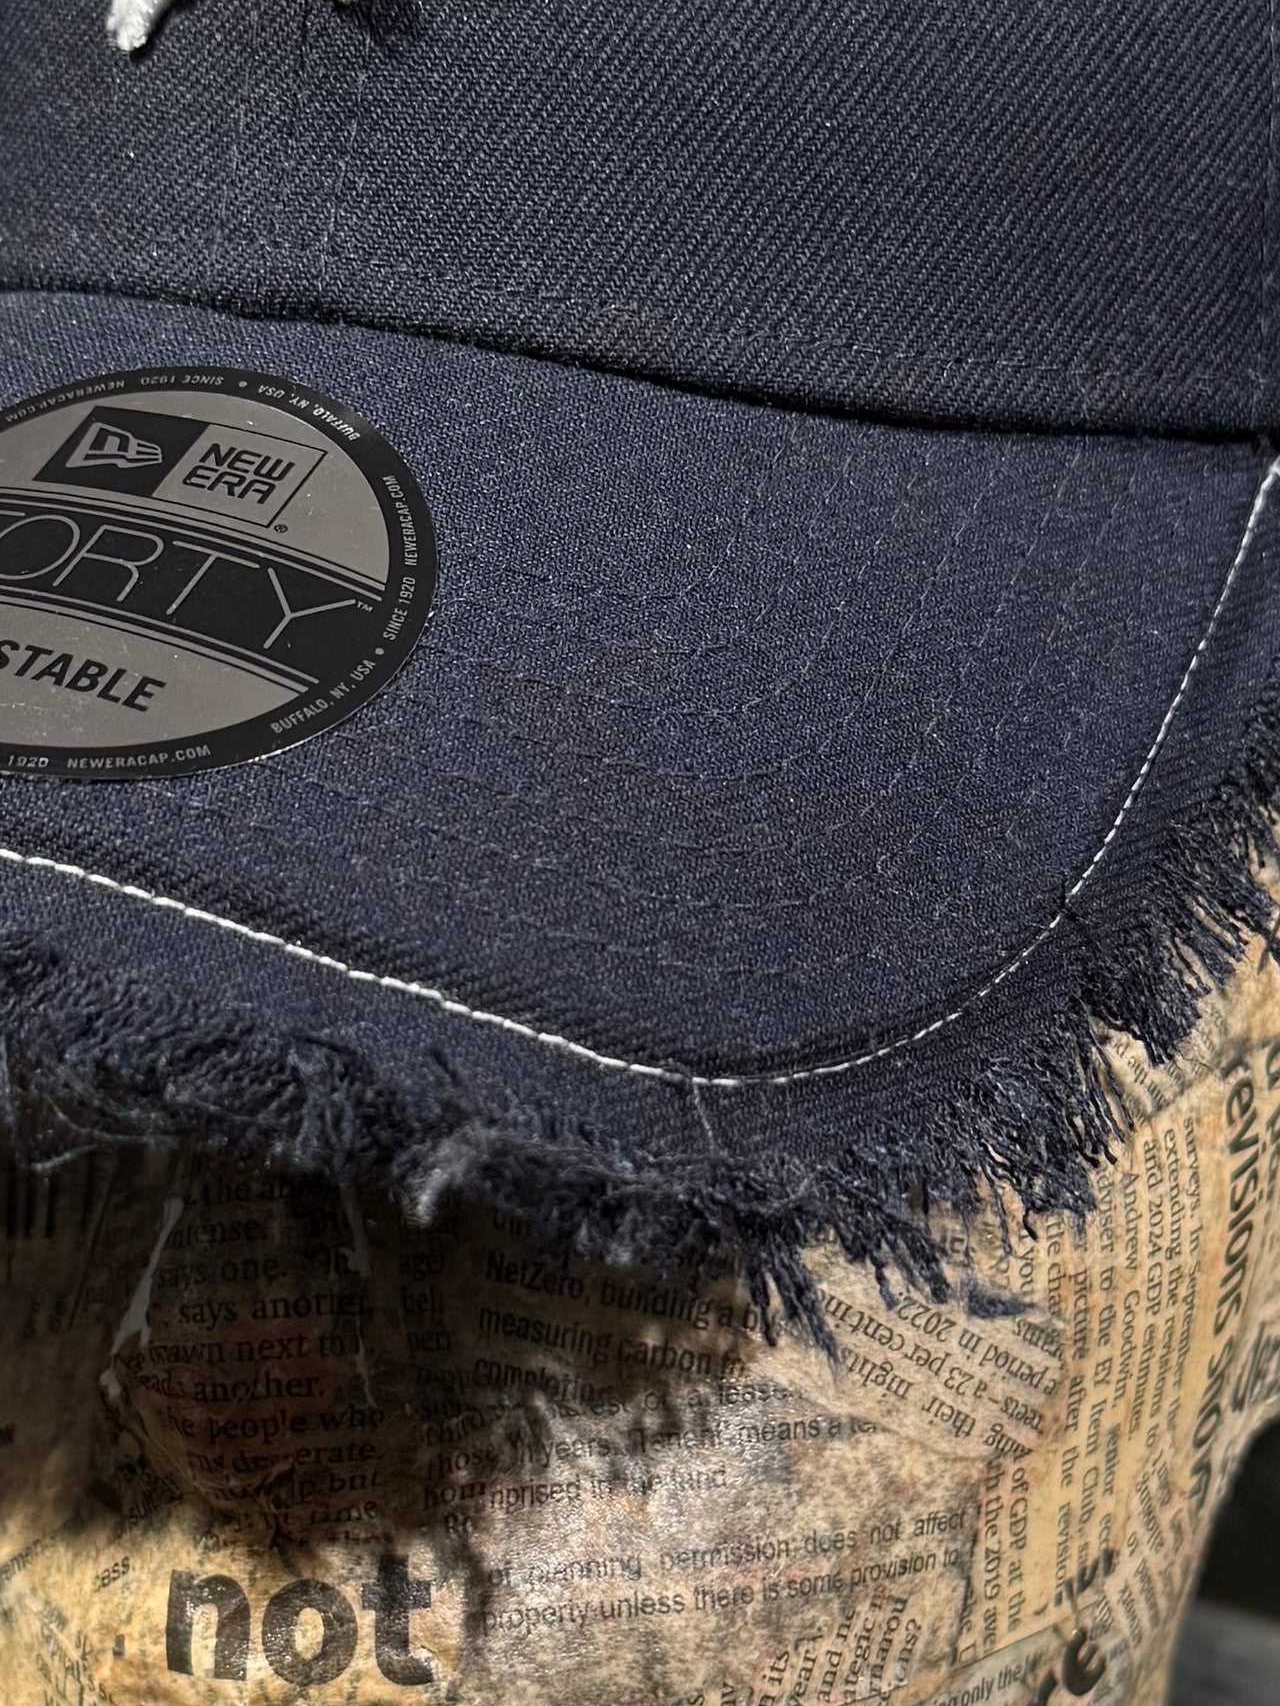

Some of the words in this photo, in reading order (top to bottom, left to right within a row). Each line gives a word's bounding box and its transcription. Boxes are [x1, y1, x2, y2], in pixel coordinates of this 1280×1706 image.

[199, 442, 296, 483] NEW
[182, 464, 277, 506] ERA
[382, 475, 418, 567] NEWERACAP.COM
[398, 576, 417, 605] 1920
[382, 607, 408, 642] SINCE
[349, 659, 377, 681] USA
[329, 682, 356, 700] NY,
[270, 698, 335, 734] BUFFALO,
[66, 744, 212, 770] NEWERACAP.COM
[1142, 1140, 1162, 1189] and
[1163, 1129, 1184, 1260] extending
[1122, 1173, 1140, 1271] Andrew
[1147, 1198, 1162, 1257] 2024
[1099, 1265, 1117, 1290] to
[1145, 1262, 1162, 1315] GDP
[1165, 1265, 1183, 1306] the
[179, 1300, 237, 1332] says
[849, 1309, 904, 1353] cent
[1068, 1269, 1089, 1360] picture
[1097, 1305, 1116, 1347] the
[236, 1332, 308, 1363] next
[478, 1306, 613, 1366] measuring
[955, 1327, 982, 1360] in
[904, 1344, 951, 1376] per
[943, 1366, 974, 1395] 23
[978, 1343, 1047, 1388] period
[318, 1404, 386, 1431] who
[921, 1394, 976, 1438] their
[1061, 1374, 1085, 1432] after
[1059, 1447, 1076, 1488] the
[870, 1522, 902, 1542] not
[1008, 1496, 1027, 1551] GDP
[599, 1593, 687, 1621] unless
[787, 1571, 845, 1596] some
[849, 1549, 936, 1589] provision
[983, 1542, 1002, 1601] 2019
[1009, 1559, 1025, 1586] at
[165, 1553, 437, 1687] not
[1005, 1590, 1025, 1633] the
[960, 1677, 993, 1706] only
